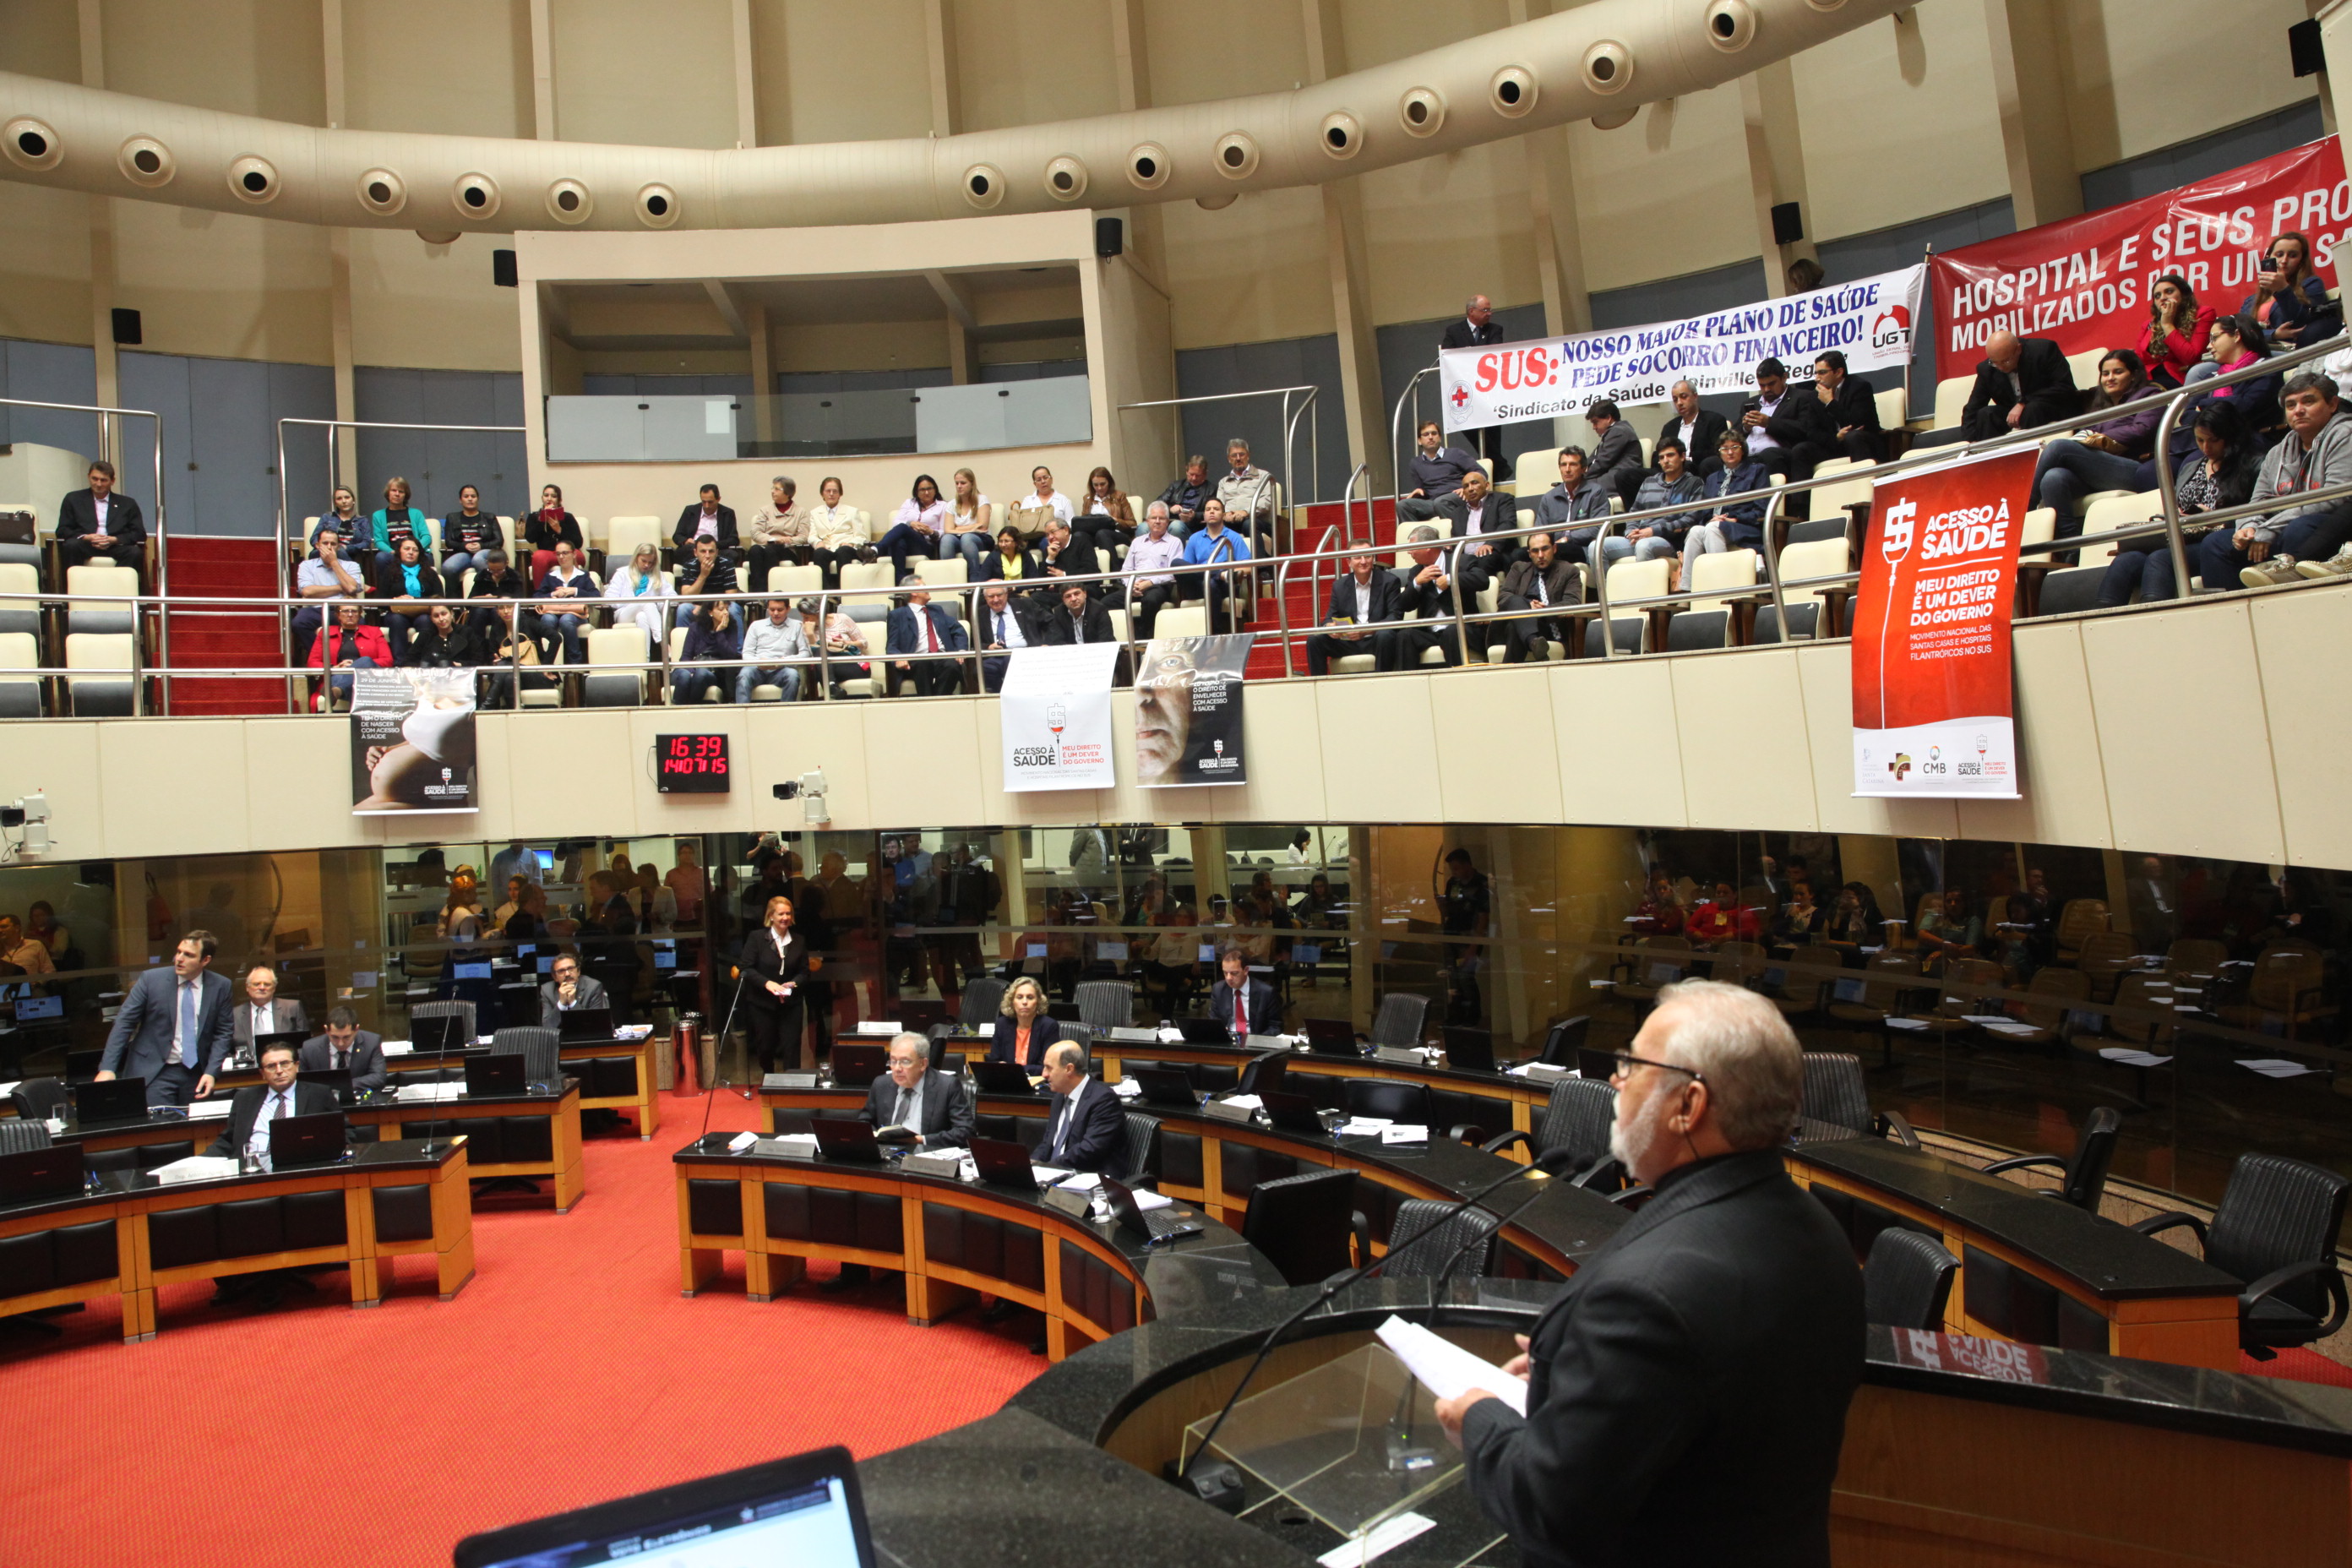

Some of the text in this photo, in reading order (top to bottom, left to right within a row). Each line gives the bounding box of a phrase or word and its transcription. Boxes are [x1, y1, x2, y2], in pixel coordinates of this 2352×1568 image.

[1953, 179, 2352, 318] HOSPITAL E SEUS PRO
[1562, 283, 1881, 364] NOSSO MAIOR PLANO DE SAÚDE
[1952, 278, 2136, 352] MOBILIZADOS
[1873, 329, 1910, 348] UGT
[1571, 314, 1864, 389] PEDE SOCORRO FINANCEIRO!
[1475, 347, 1559, 392] SUS:
[1582, 394, 1602, 406] da
[1609, 384, 1666, 403] Saúde
[1925, 498, 2009, 534] ACESSO À
[1920, 520, 2008, 559] SAÚDE
[1915, 569, 2000, 593] MEU DIREITO
[1912, 585, 1996, 610] É UM DEVER
[1910, 602, 1993, 626] DO GOVERNO
[1910, 624, 1991, 640] MOVIMENTO NACIONAL DAS
[1910, 641, 1935, 651] SANTAS
[1935, 639, 1954, 648] CASAS
[1960, 634, 1991, 645] HOSPITAIS
[1910, 645, 1991, 661] FILANTRÓPICOS NO SUS
[670, 737, 722, 757] 16 39
[1014, 744, 1054, 755] ACESSO À
[1014, 754, 1056, 766] SAÚDE
[1923, 763, 1946, 774] CMB
[1958, 767, 1981, 776] SAÚDE
